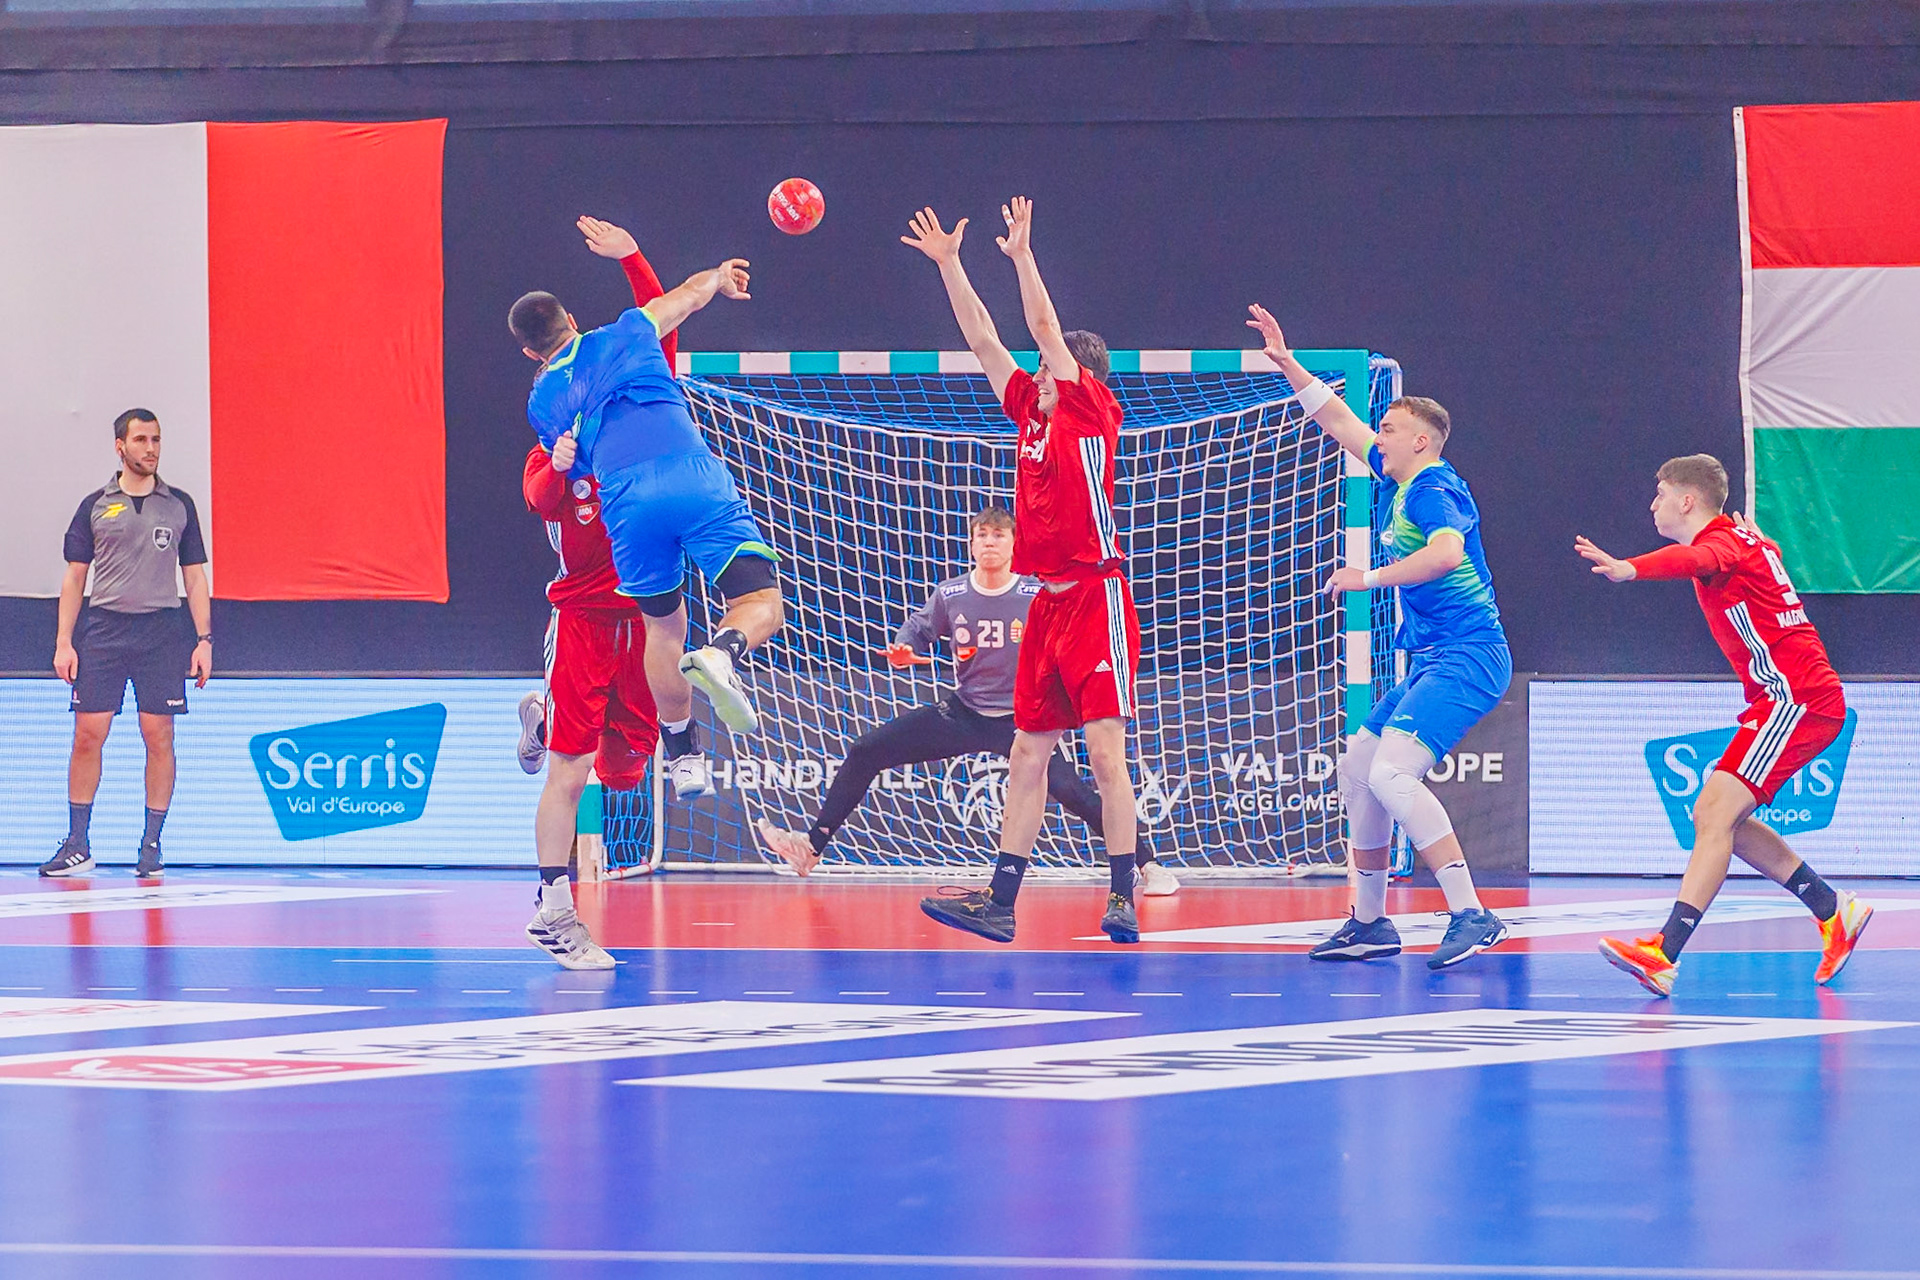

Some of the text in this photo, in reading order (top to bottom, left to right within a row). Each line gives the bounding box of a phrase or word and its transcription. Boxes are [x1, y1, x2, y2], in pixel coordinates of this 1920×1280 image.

[977, 620, 1004, 648] 23
[265, 737, 426, 790] Serris
[1220, 752, 1293, 782] VAL
[286, 796, 406, 817] Val d'Europe
[1223, 790, 1345, 812] AGGLOMÉ
[823, 1016, 1763, 1090] ACADOMIA
